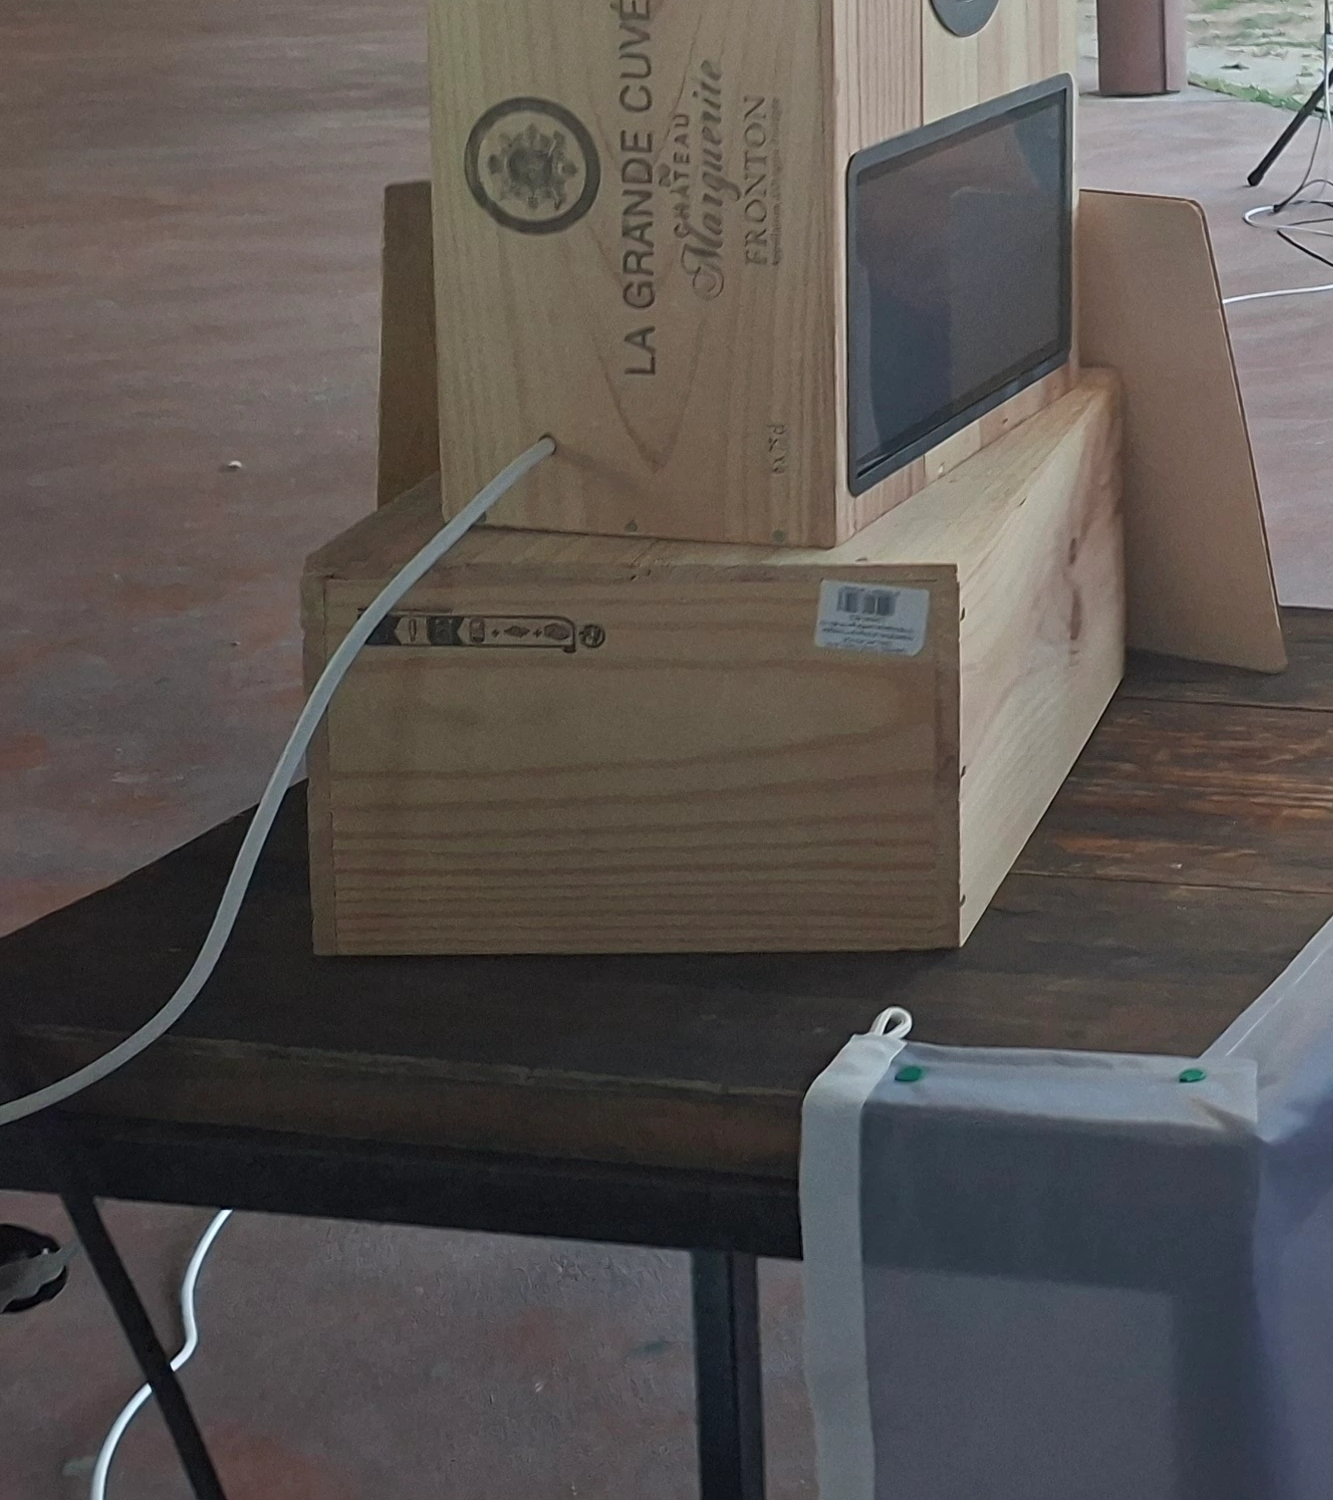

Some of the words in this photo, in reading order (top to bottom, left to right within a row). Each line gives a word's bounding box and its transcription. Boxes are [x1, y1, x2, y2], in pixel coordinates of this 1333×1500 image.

[621, 130, 655, 309] GRANDE
[670, 114, 691, 238] CHÂTEAU
[681, 60, 742, 301] Marguerite
[743, 96, 767, 265] FRONTON
[624, 326, 656, 376] LA
